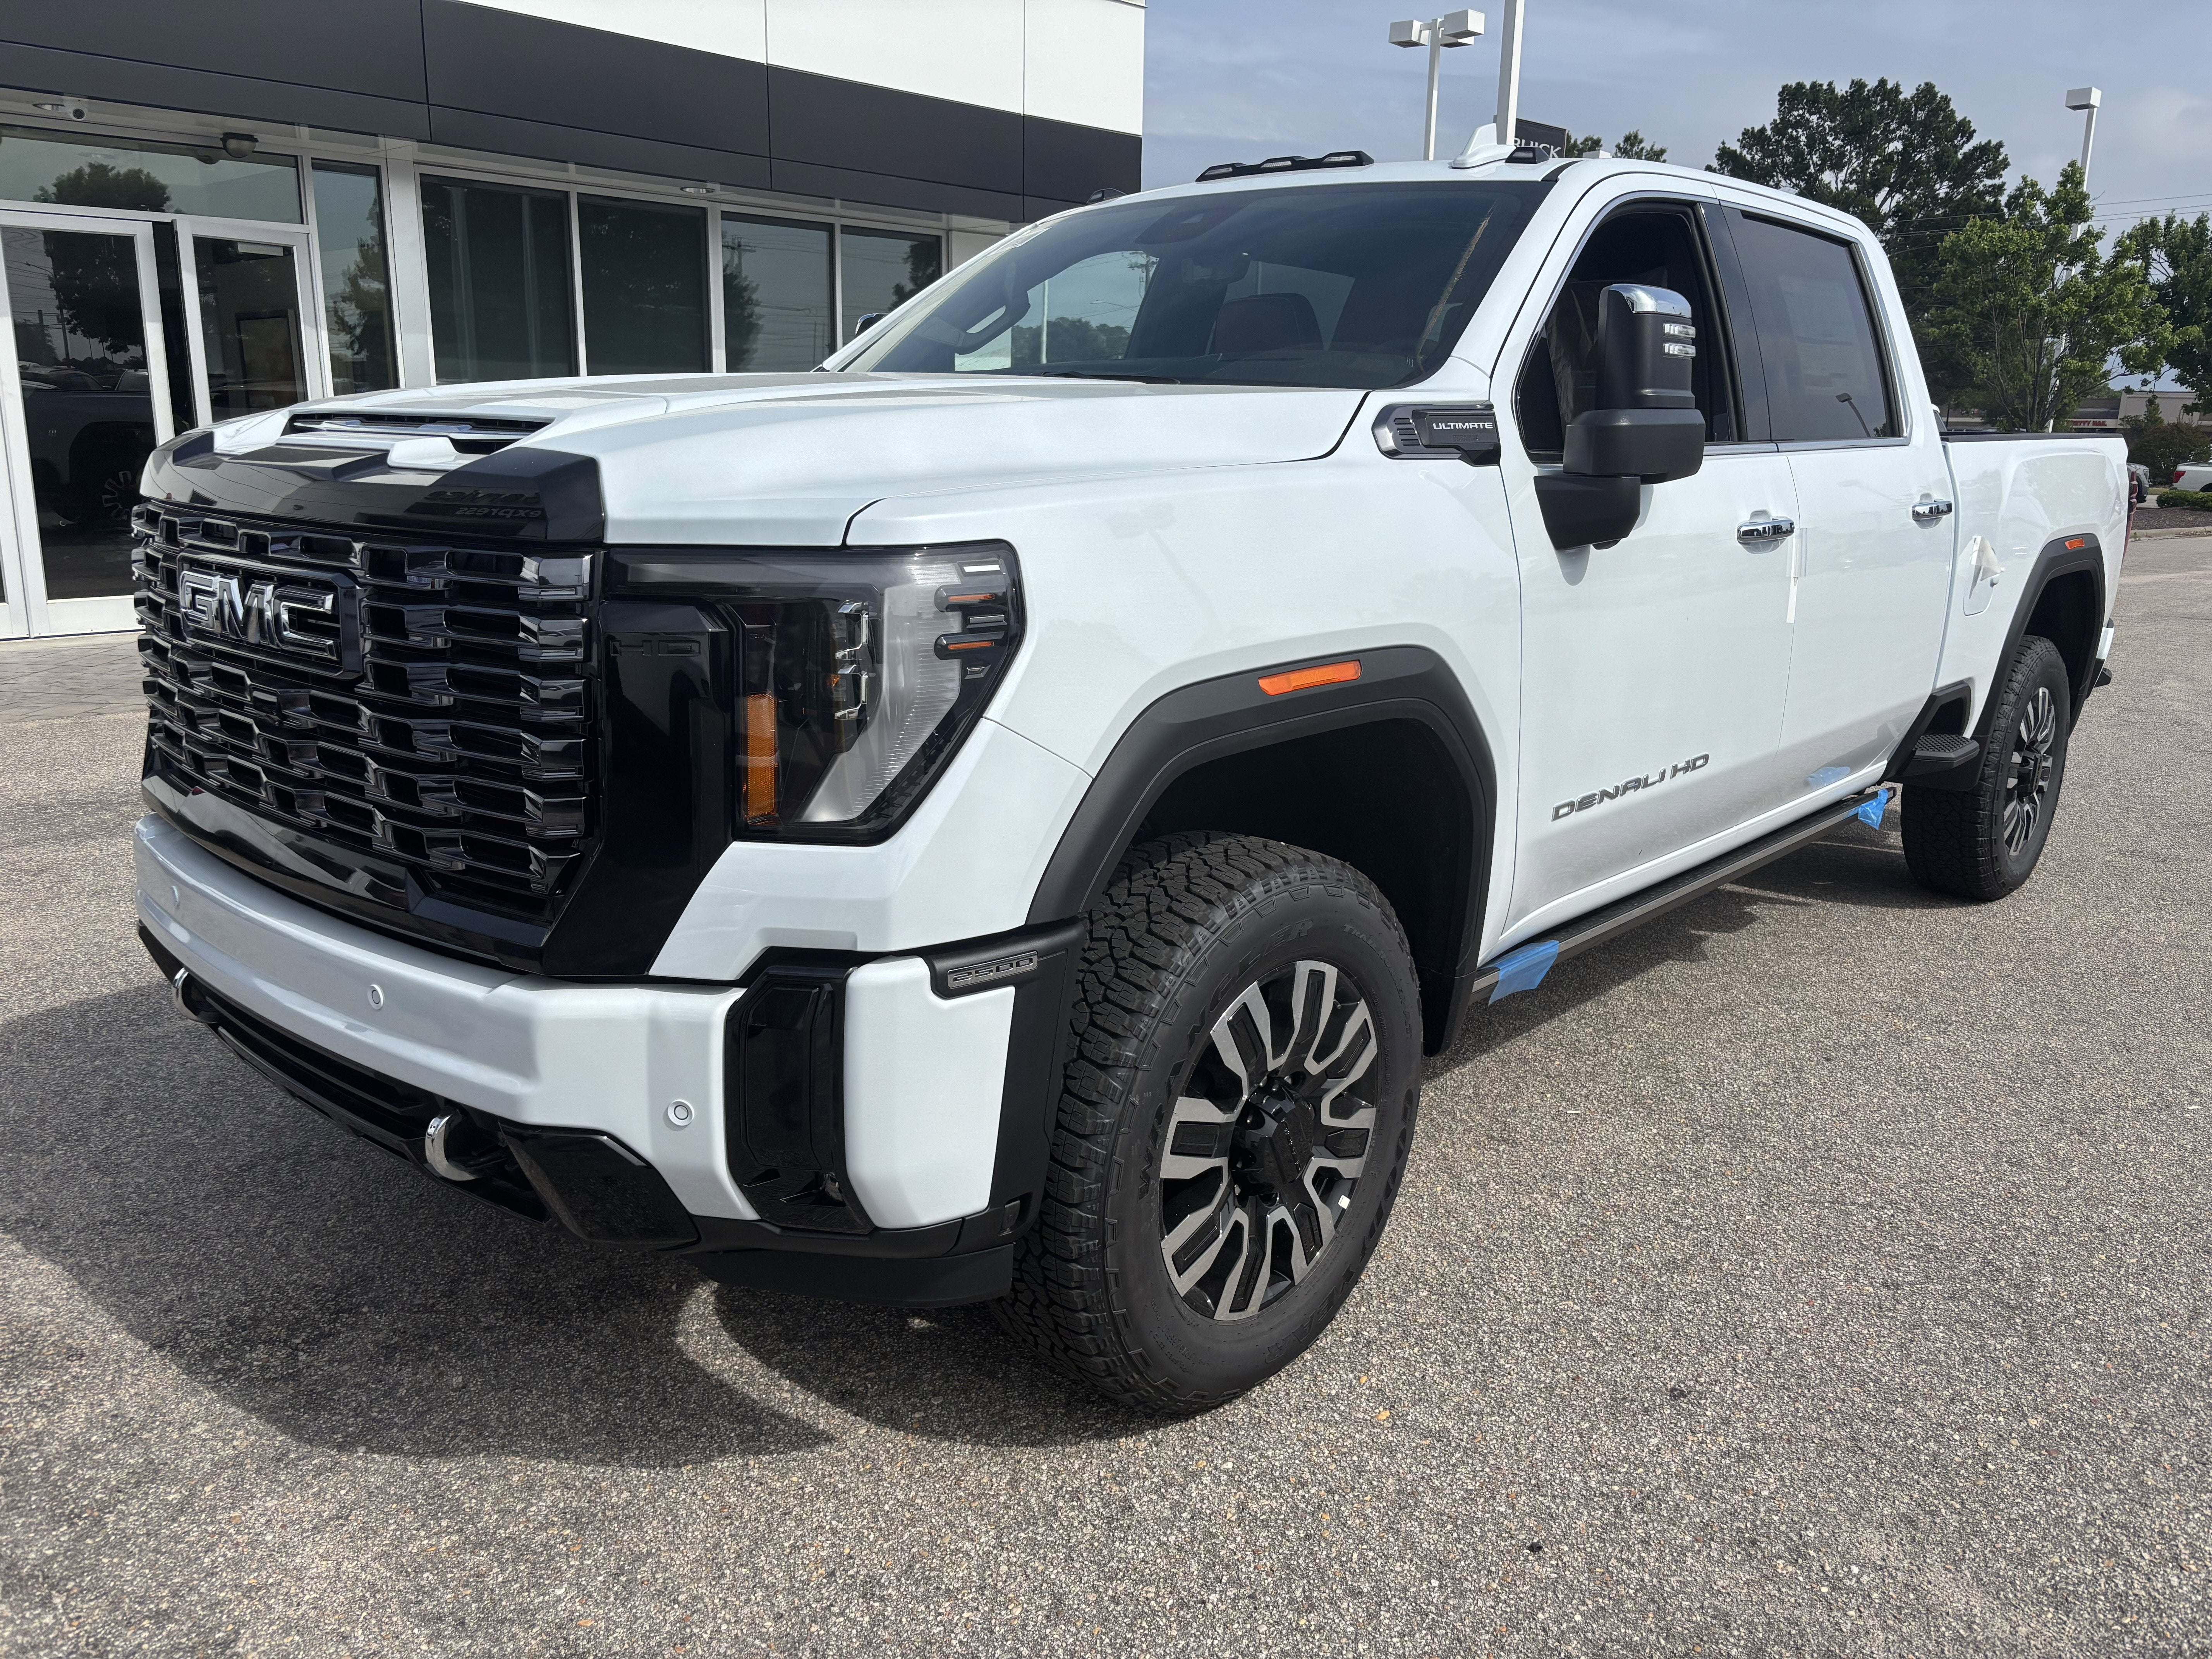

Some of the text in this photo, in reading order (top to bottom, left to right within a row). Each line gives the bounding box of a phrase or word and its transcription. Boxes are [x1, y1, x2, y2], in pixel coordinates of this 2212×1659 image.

[180, 571, 337, 660] GMC
[610, 640, 701, 657] HD
[1552, 752, 1709, 822] DENALI HD
[953, 958, 1033, 982] 2500
[1138, 918, 1314, 1203] WRANGLER
[1265, 1088, 1414, 1364] GOODYEAR
